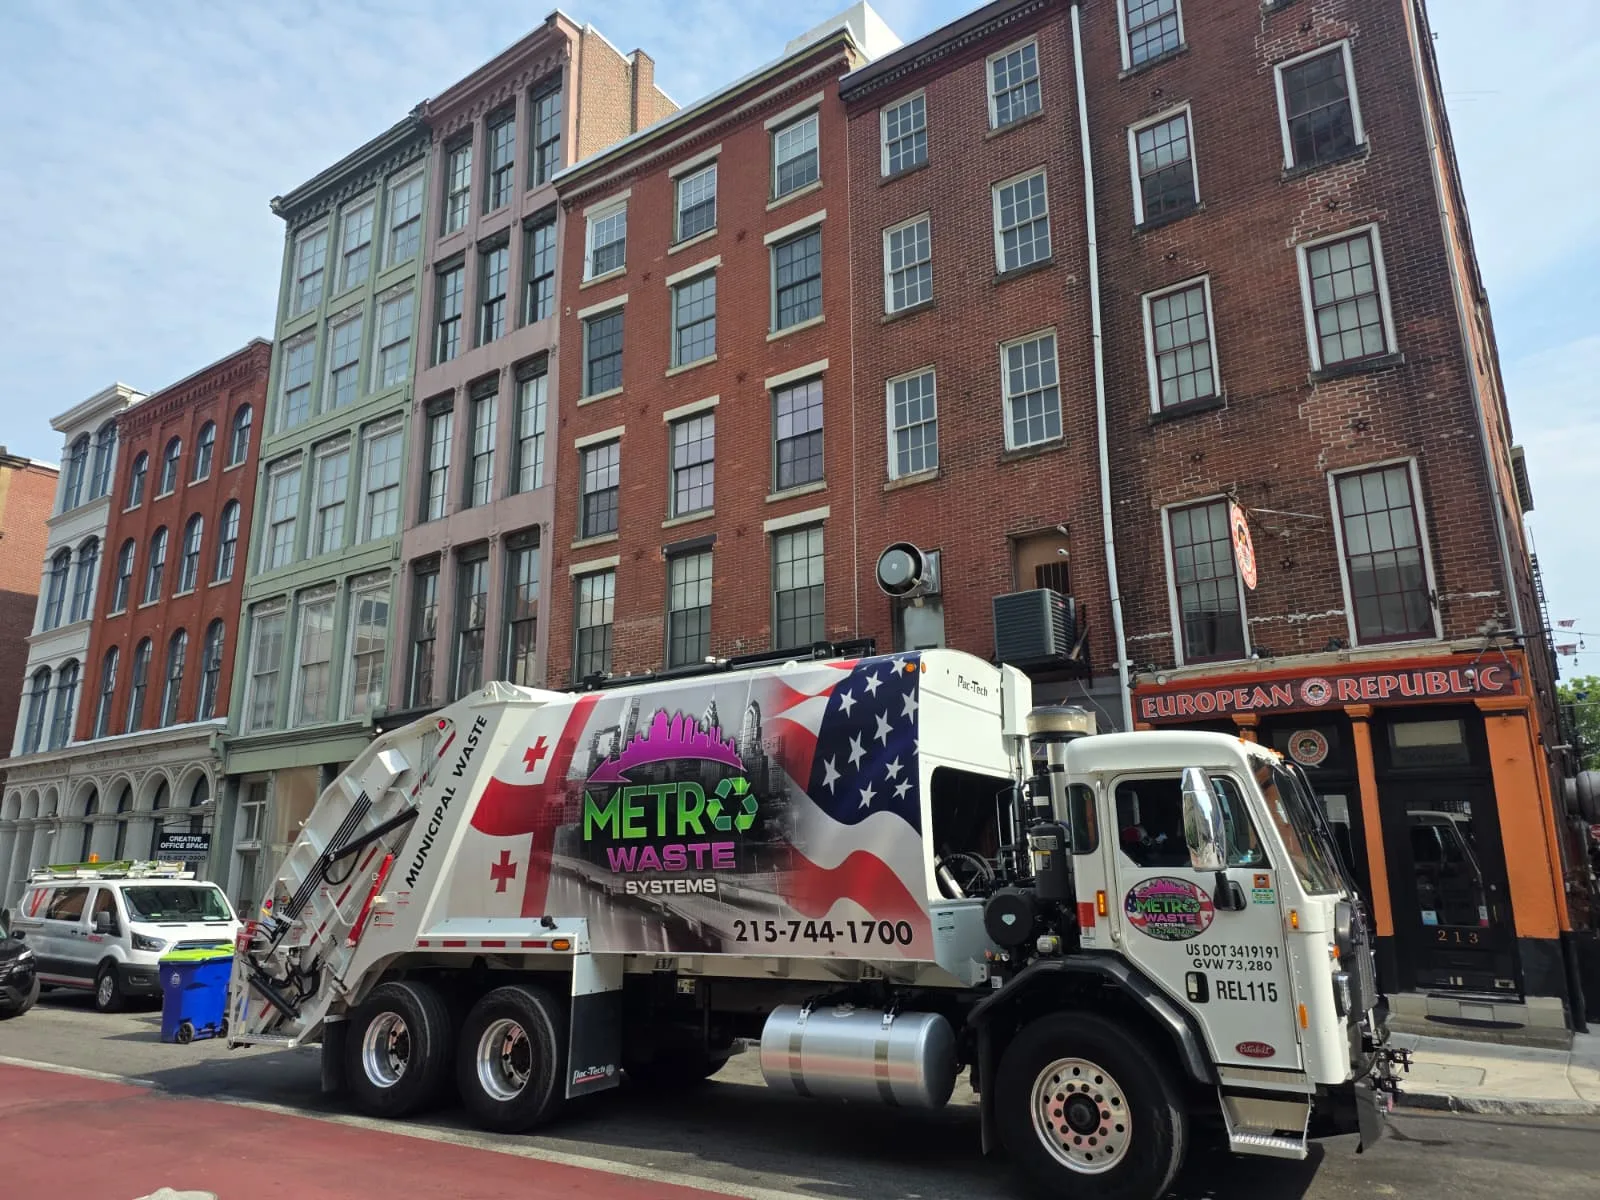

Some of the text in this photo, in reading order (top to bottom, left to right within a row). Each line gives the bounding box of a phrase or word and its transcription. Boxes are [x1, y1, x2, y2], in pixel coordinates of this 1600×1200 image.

[957, 675, 988, 696] Pac-Tech
[1141, 683, 1295, 718] EUROPEAN
[1337, 667, 1504, 700] REPUBLIC
[405, 714, 487, 889] MUNICIPAL WASTE
[607, 842, 736, 873] WASTE
[626, 878, 717, 895] SYSTEMS
[1144, 913, 1196, 923] WASTE
[733, 919, 914, 946] 215-744-1700
[1186, 944, 1279, 959] US DOT 3419191
[1193, 958, 1273, 972] GVW 73,280
[1216, 979, 1278, 1003] REL115
[572, 1066, 606, 1085] Pac-Tech
